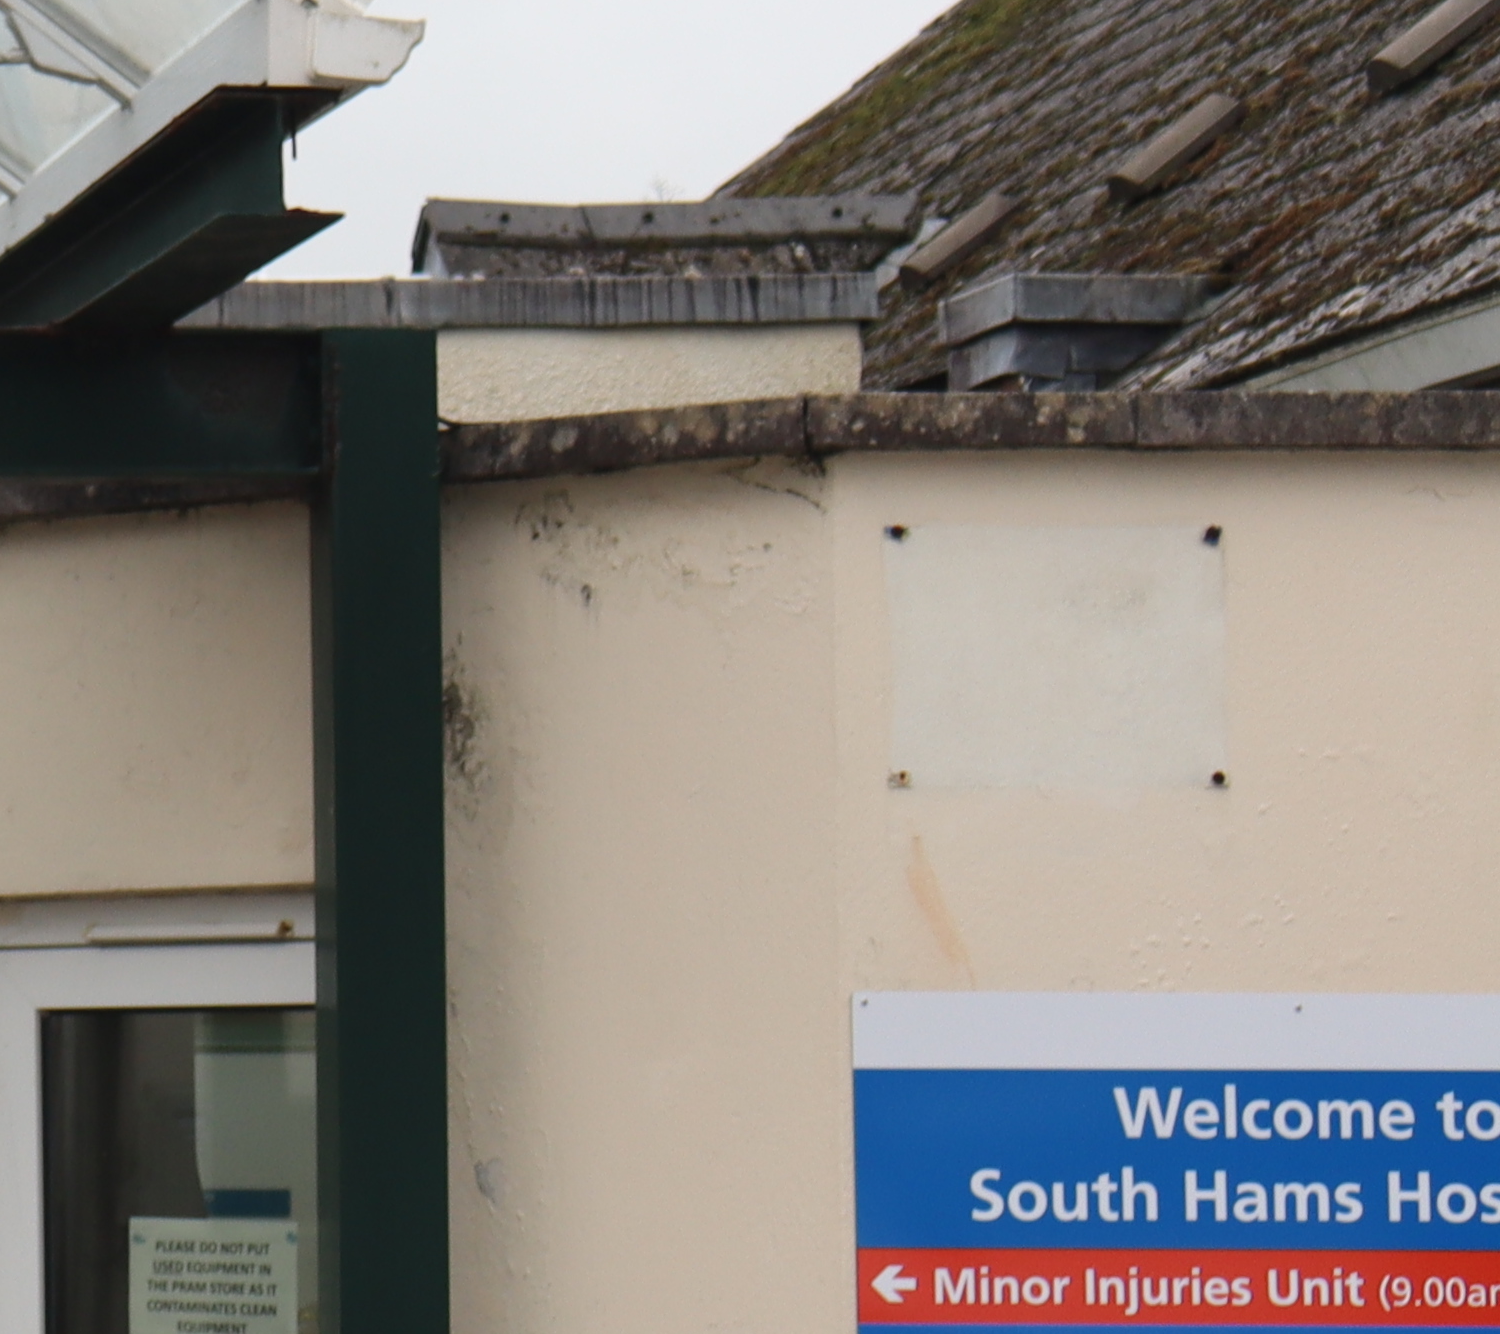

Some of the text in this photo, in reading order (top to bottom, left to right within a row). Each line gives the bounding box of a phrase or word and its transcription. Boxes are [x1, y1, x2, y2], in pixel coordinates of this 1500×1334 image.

[1113, 1083, 1500, 1140] Welcome to
[969, 1167, 1159, 1222] South
[1184, 1169, 1363, 1223] Hams
[155, 1241, 270, 1255] PLEASE DO NOT PUT
[153, 1262, 272, 1276] USED EQUIPMENT IN
[148, 1281, 168, 1292] THE
[172, 1282, 206, 1294] PRAM
[210, 1283, 245, 1295] STORE
[250, 1284, 263, 1296] AS
[934, 1267, 1070, 1307] Minor
[1085, 1269, 1252, 1315] Injuries
[1267, 1270, 1365, 1307] Unit
[147, 1301, 277, 1316] CONTAMINATES CLEAN
[177, 1321, 248, 1334] EQUIPMENT
